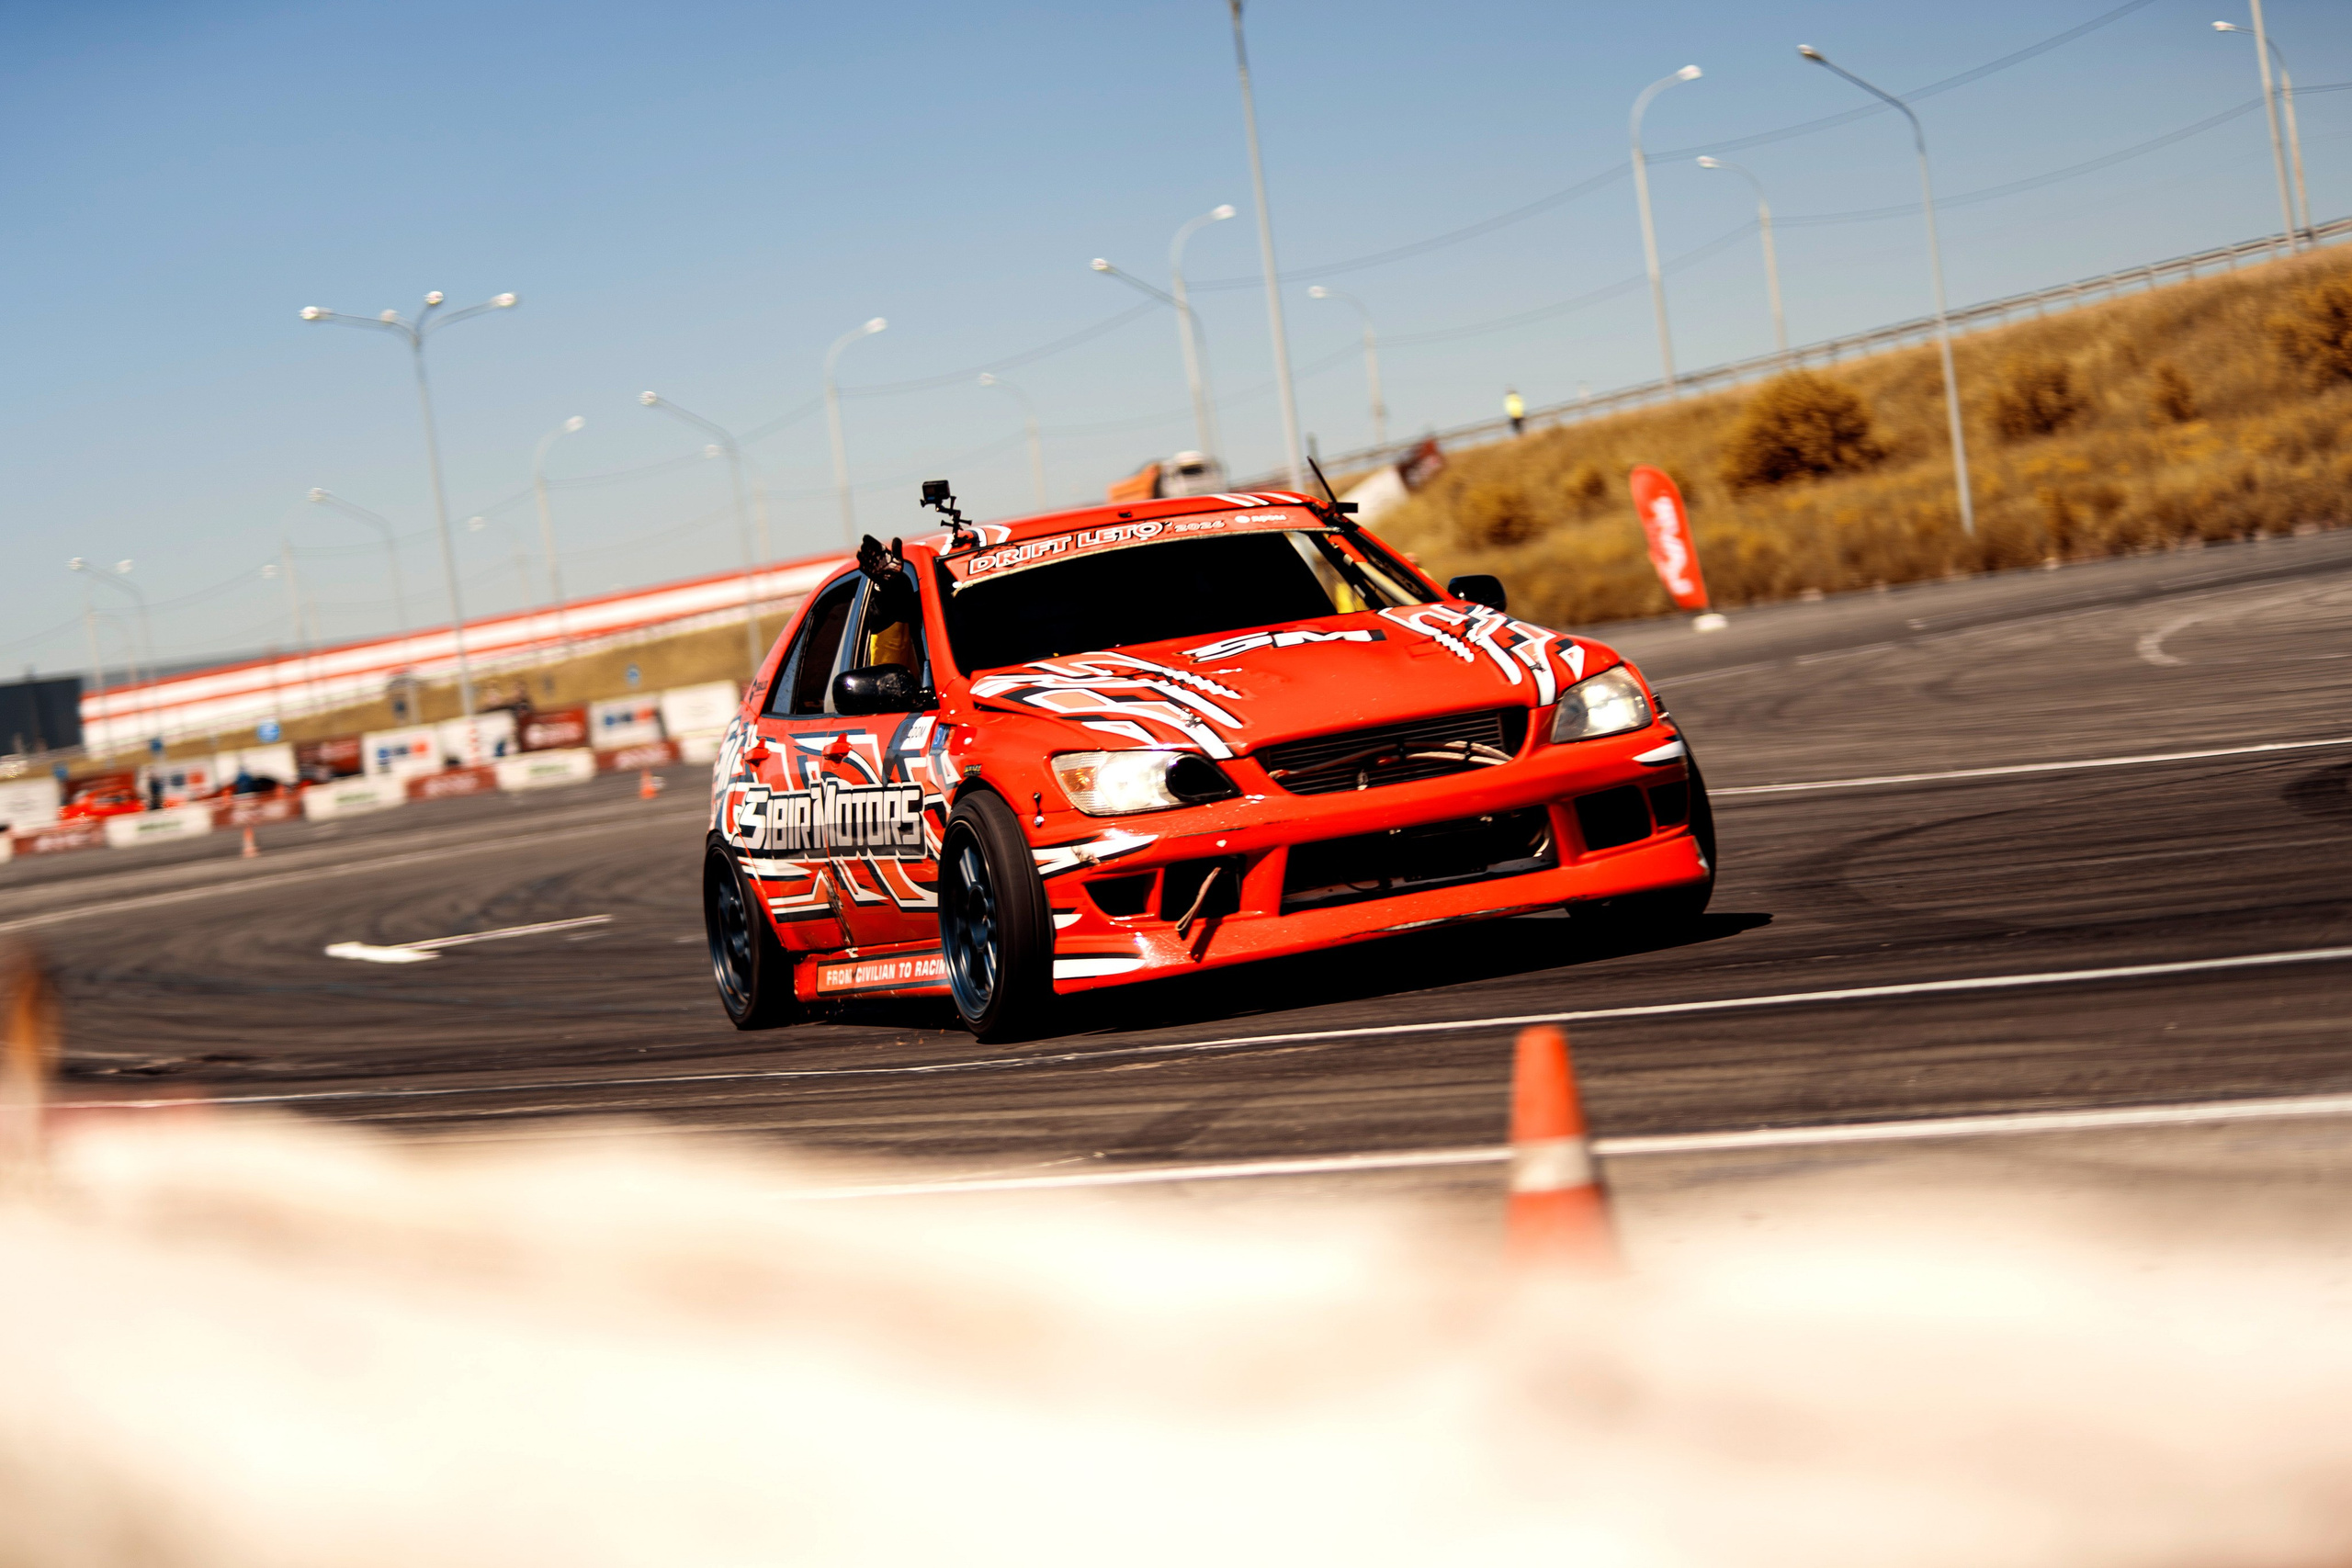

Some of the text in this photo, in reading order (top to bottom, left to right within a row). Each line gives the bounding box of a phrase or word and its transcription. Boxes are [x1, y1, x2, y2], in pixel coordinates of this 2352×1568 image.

[969, 536, 1072, 575] DRIFT
[1077, 521, 1163, 548] LETO
[1177, 629, 1378, 662] SM
[827, 958, 945, 986] FROM CIVILIAN TO RACIN
